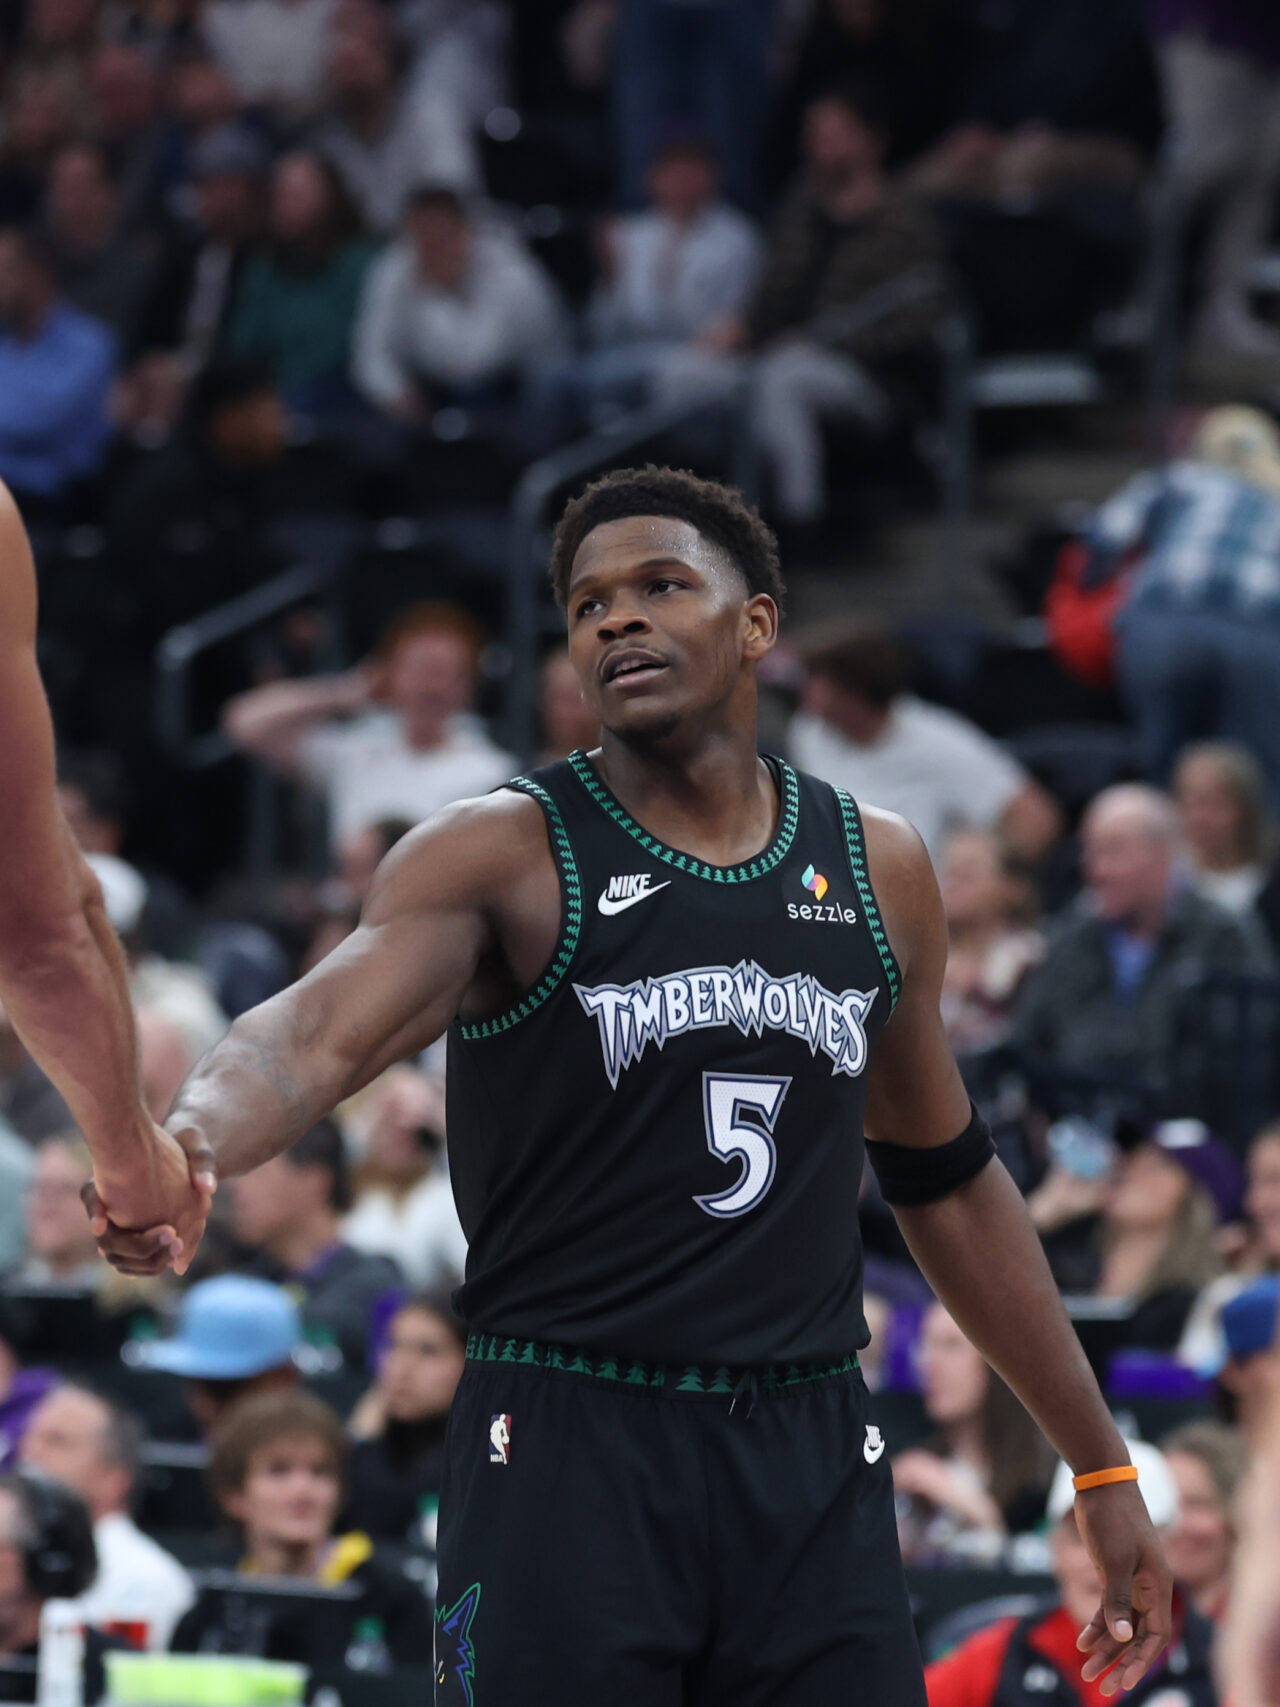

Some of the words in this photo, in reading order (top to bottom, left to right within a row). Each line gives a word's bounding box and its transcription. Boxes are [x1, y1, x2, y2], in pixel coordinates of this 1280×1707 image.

[607, 873, 652, 899] NIKE
[787, 902, 857, 924] sezzle
[573, 959, 879, 1091] TIMBERWOLVES
[692, 1071, 793, 1218] 5
